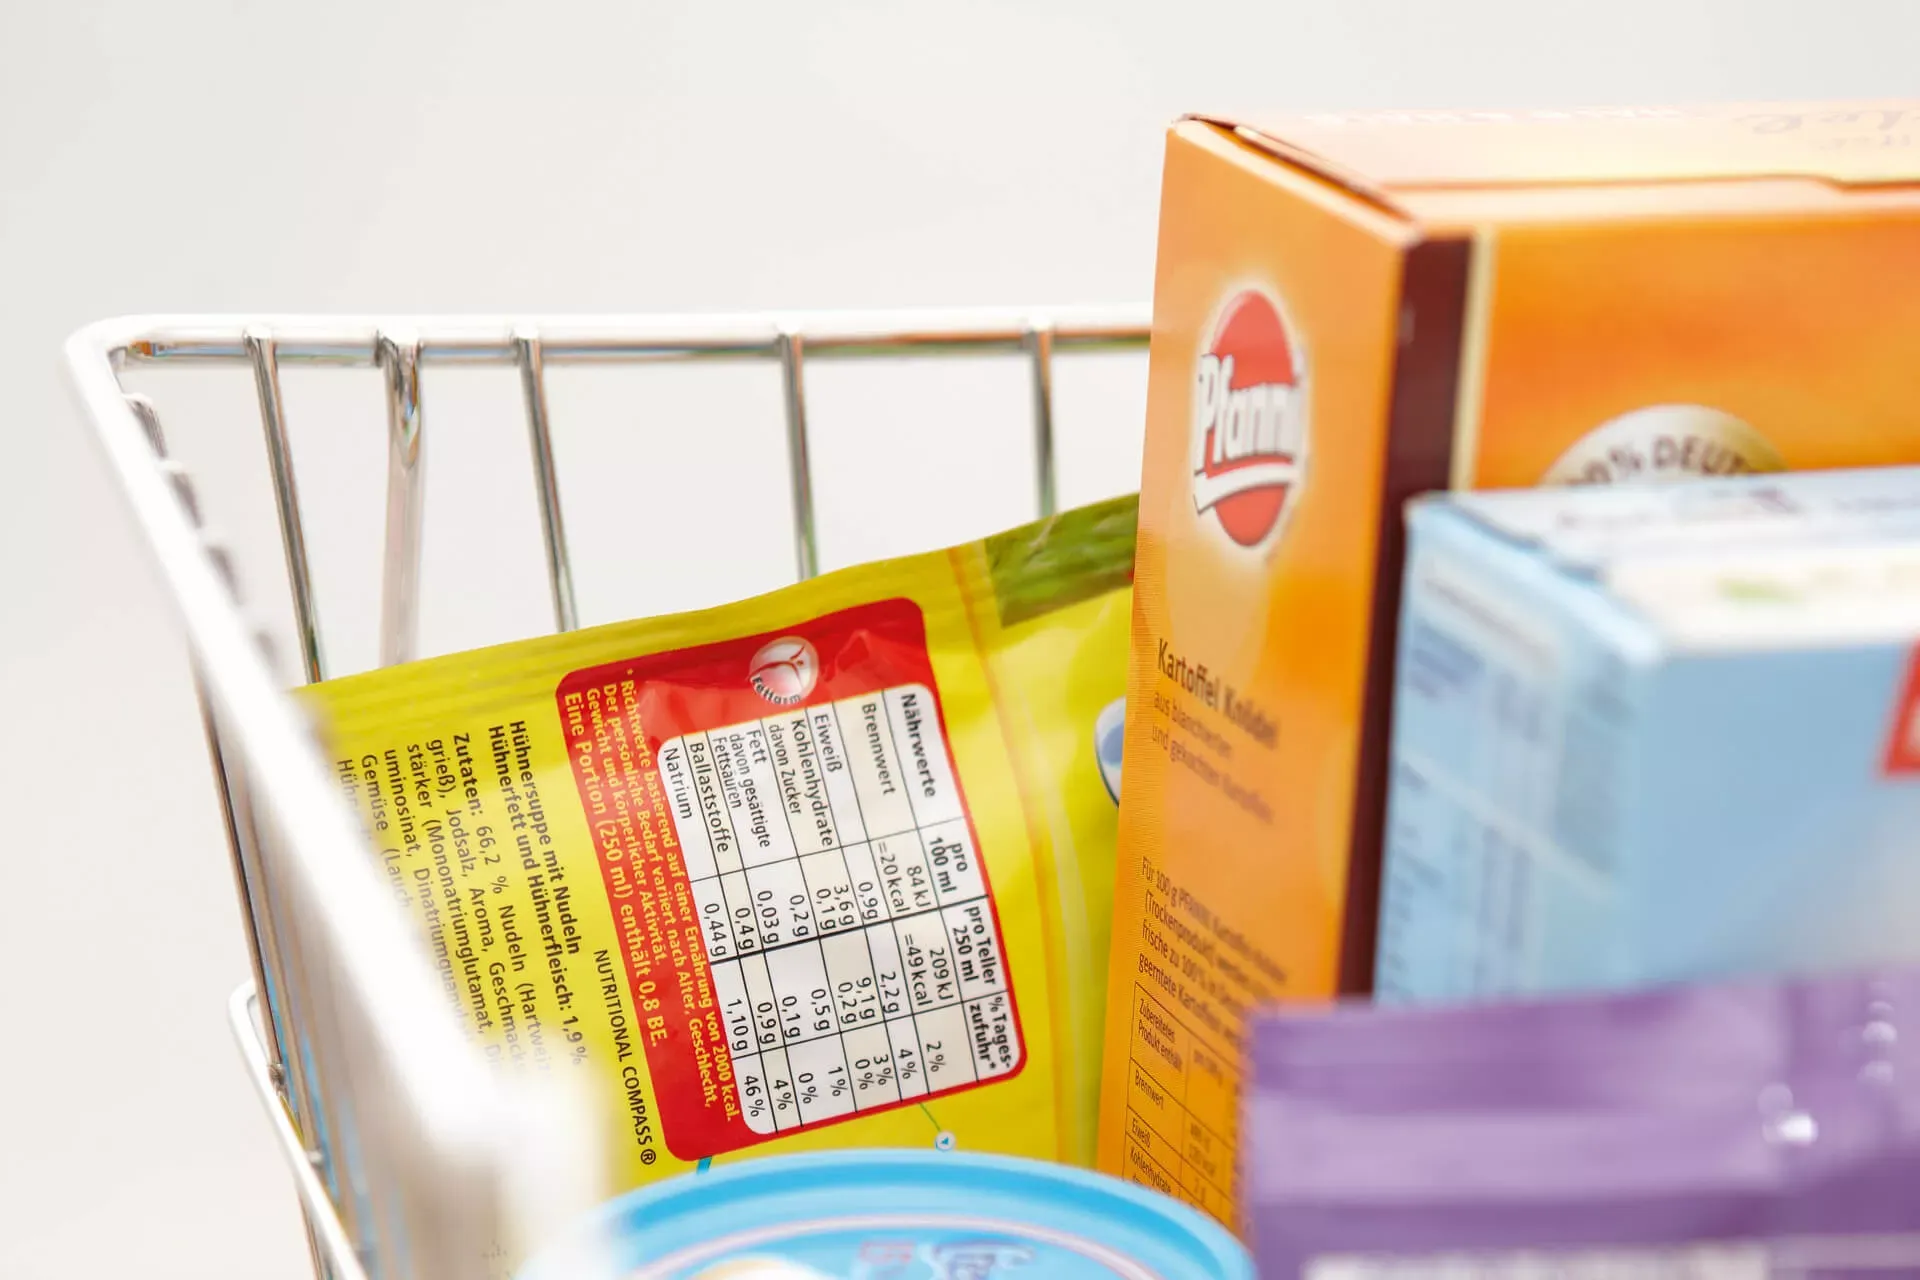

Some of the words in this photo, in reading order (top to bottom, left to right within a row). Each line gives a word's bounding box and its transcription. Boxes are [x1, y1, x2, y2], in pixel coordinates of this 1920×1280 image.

[602, 682, 619, 713] Der
[1157, 637, 1220, 712] Kartoffel
[563, 691, 585, 737] Eine
[585, 687, 612, 755] Gewicht
[619, 679, 651, 768] Richtwerte
[1153, 692, 1171, 717] aus
[605, 716, 644, 807] persönliche
[727, 733, 750, 776] davon
[745, 729, 767, 764] Fett
[813, 713, 843, 773] Eiweiß
[860, 702, 896, 795] Brennwert
[900, 693, 936, 797] Nährwerte
[452, 732, 483, 817] Zutaten:
[487, 724, 527, 831] Hühnerfett
[508, 719, 551, 846] Hühnersuppe
[573, 739, 607, 815] Portion
[601, 756, 623, 789] und
[662, 747, 692, 820] Natrium
[711, 736, 742, 809] Fettsäuren
[767, 723, 789, 773] davon
[779, 768, 801, 814] Zucker
[790, 718, 833, 846] Kohlenhydrate
[360, 753, 389, 832] Gemüse
[383, 748, 421, 857] uminosinat,
[642, 769, 676, 849] basierend
[688, 741, 732, 853] Ballaststoffe
[737, 778, 770, 848] gesättigte
[424, 738, 457, 799] grieß),
[444, 809, 477, 878] Jodsalz,
[468, 887, 494, 953] Aroma,
[474, 825, 501, 866] 66,2
[514, 833, 539, 871] und
[593, 818, 624, 862] (250
[611, 788, 647, 885] körperlicher
[635, 808, 662, 862] Bedarf
[928, 836, 949, 867] 100
[943, 842, 968, 873] pro
[490, 875, 509, 895] %
[542, 849, 564, 883] mit
[608, 865, 634, 899] ml)
[665, 851, 685, 878] auf
[905, 864, 925, 888] 84
[936, 870, 957, 894] ml
[1143, 856, 1155, 883] Für
[405, 743, 432, 808] stärker
[420, 818, 494, 1034] (Mononatriumglutamat,
[651, 865, 677, 926] variiert
[672, 881, 693, 922] einer
[886, 876, 911, 913] kcal
[912, 888, 931, 908] kJ
[497, 904, 527, 973] Nudeln
[526, 873, 574, 1012] Hühnerfleisch:
[551, 885, 582, 955] Nudeln
[619, 903, 651, 978] enthält
[637, 890, 667, 966] Aktivität.
[951, 924, 972, 956] 250
[1142, 919, 1169, 959] frische
[665, 928, 687, 968] nach
[683, 925, 713, 1009] Ernährung
[928, 947, 950, 980] 209
[962, 905, 985, 935] pro
[975, 936, 997, 985] Teller
[675, 970, 695, 1015] Alter,
[910, 969, 933, 1007] kcal
[935, 981, 954, 1001] kJ
[959, 958, 979, 982] ml
[637, 980, 660, 1012] 0,8
[988, 995, 1004, 1013] %
[561, 1014, 583, 1043] 1,9
[592, 948, 633, 1063] NUTRITIONAL
[621, 1065, 653, 1146] COMPASS
[645, 1014, 668, 1048] BE.
[704, 1010, 721, 1042] von
[986, 1012, 1018, 1068] Tages-
[687, 1017, 718, 1108] Geschlecht,
[711, 1043, 732, 1082] 2000
[720, 1082, 740, 1122] kcal.
